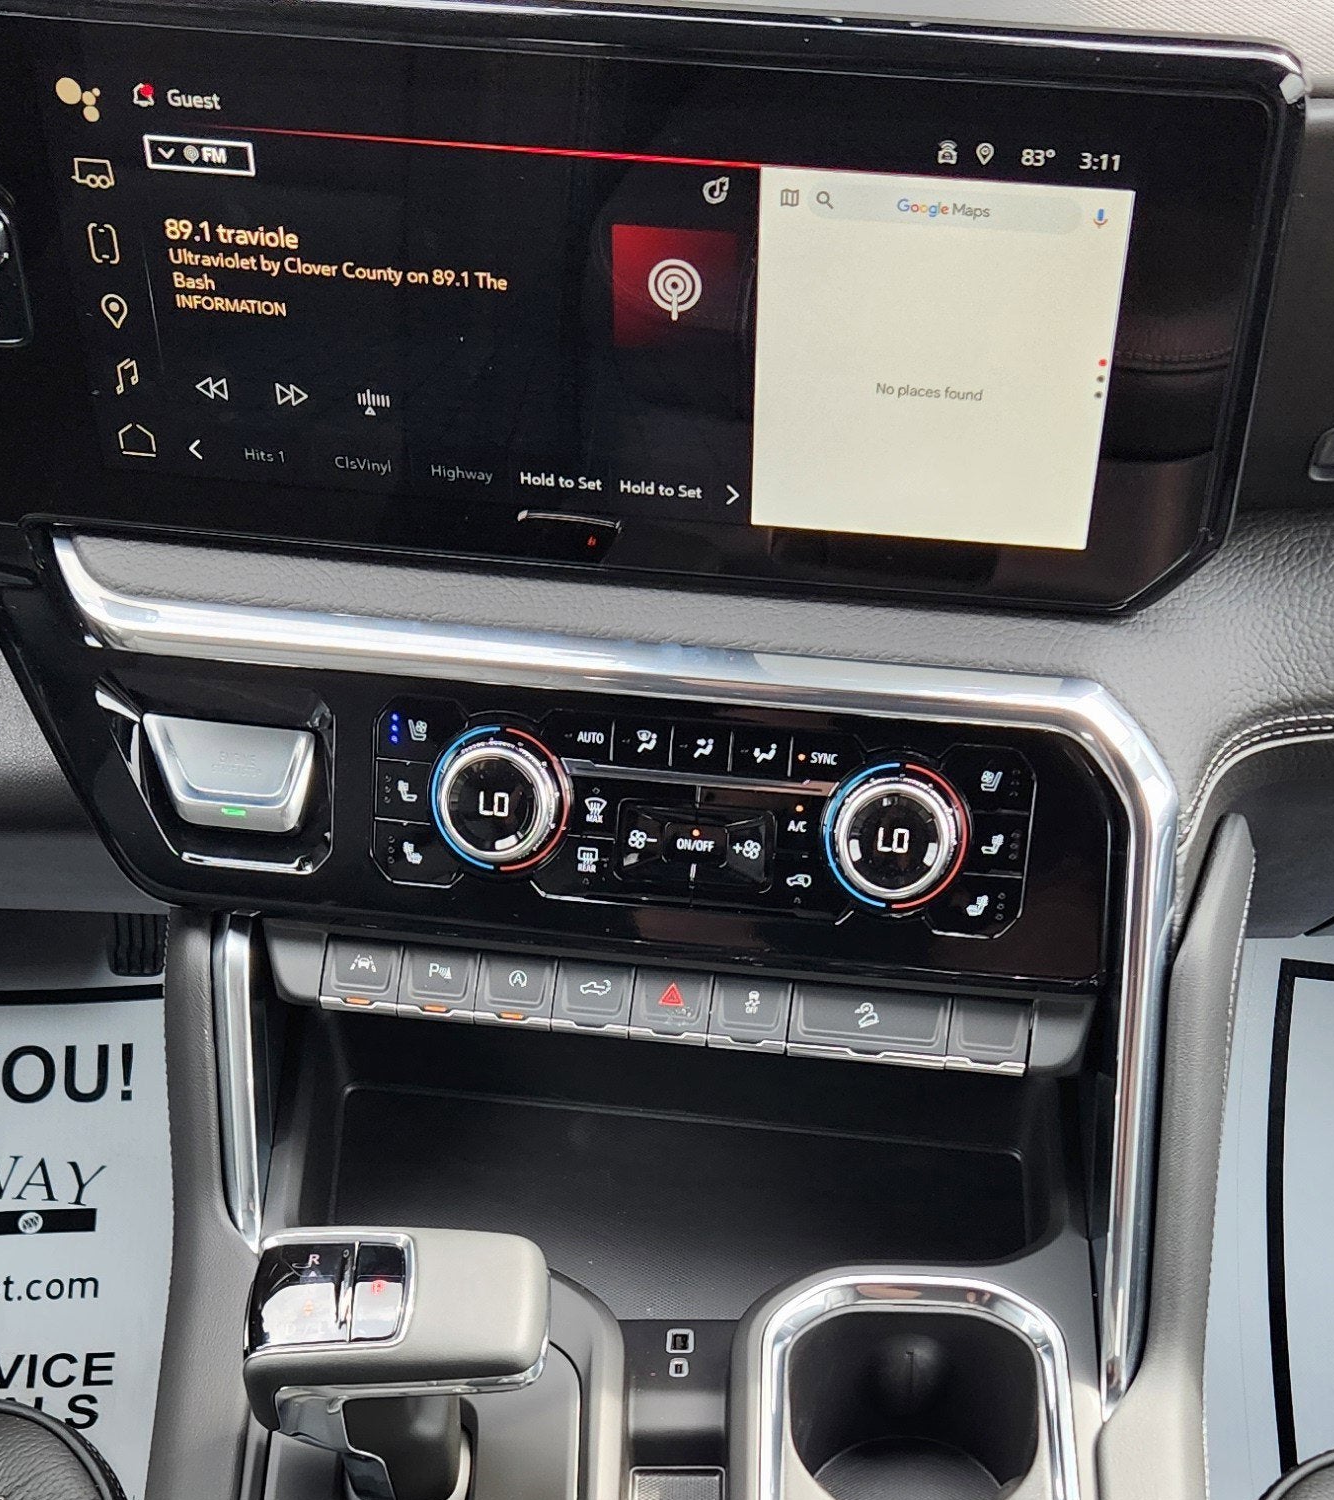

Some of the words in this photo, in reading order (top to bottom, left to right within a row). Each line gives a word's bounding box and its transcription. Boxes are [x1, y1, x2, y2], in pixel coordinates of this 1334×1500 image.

[167, 88, 222, 111] Guest
[200, 146, 228, 165] FM
[1021, 148, 1056, 168] 83°
[1079, 152, 1121, 173] 3:11
[897, 197, 949, 219] Google
[952, 202, 991, 220] Maps
[164, 218, 212, 244] 89.1
[217, 223, 300, 250] traviole
[168, 248, 258, 273] Ultraviolet
[260, 256, 281, 278] by
[284, 257, 338, 281] Clover
[341, 262, 402, 287] County
[406, 269, 430, 285] on
[432, 267, 471, 289] 89.1
[474, 271, 509, 292] The
[173, 271, 216, 292] Bash
[175, 294, 288, 318] INFORMATION
[875, 381, 895, 397] No
[898, 382, 941, 402] places
[944, 384, 984, 402] found
[244, 446, 276, 464] Hits
[277, 449, 286, 464] 1
[334, 455, 393, 475] ClsVinyl
[430, 463, 494, 484] Highway
[519, 470, 555, 489] Hold
[558, 474, 573, 491] to
[576, 475, 602, 492] Set
[619, 478, 655, 497] Hold
[659, 482, 673, 498] to
[676, 483, 703, 500] Set
[577, 731, 605, 745] AUTO
[810, 752, 838, 766] SYNC
[787, 820, 808, 833] A/C
[676, 838, 715, 853] ON/OFF
[308, 1253, 321, 1265] R
